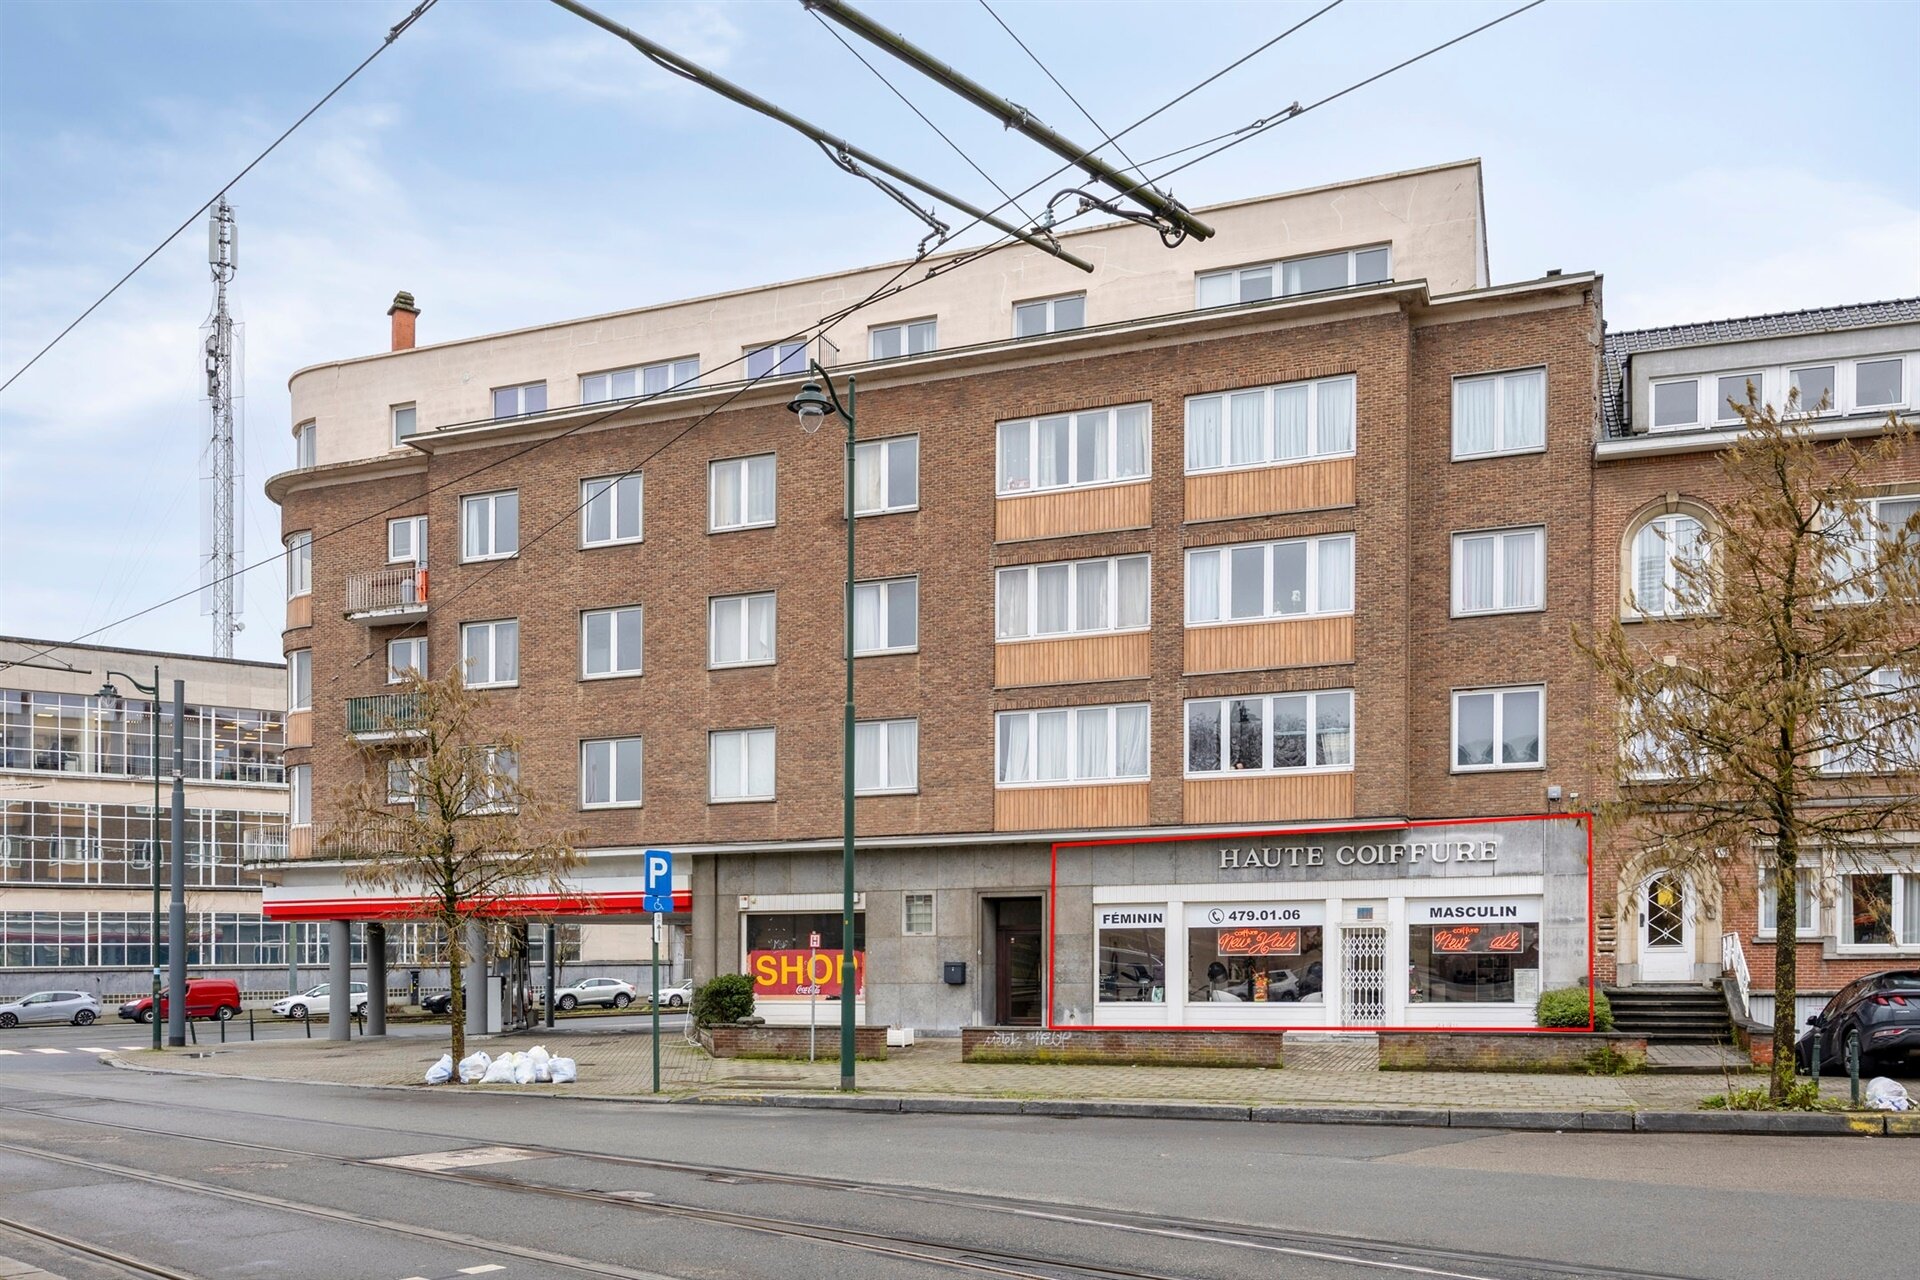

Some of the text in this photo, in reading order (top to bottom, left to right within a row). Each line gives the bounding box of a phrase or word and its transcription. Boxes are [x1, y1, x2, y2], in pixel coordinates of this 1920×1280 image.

[1219, 841, 1498, 869] HAUTE COIFFURE
[650, 857, 668, 889] P
[1102, 911, 1163, 924] FÉMININ
[1228, 909, 1301, 921] 479.01.06
[1430, 906, 1517, 918] MASCULIN
[1219, 933, 1251, 951] New
[1435, 931, 1470, 951] New
